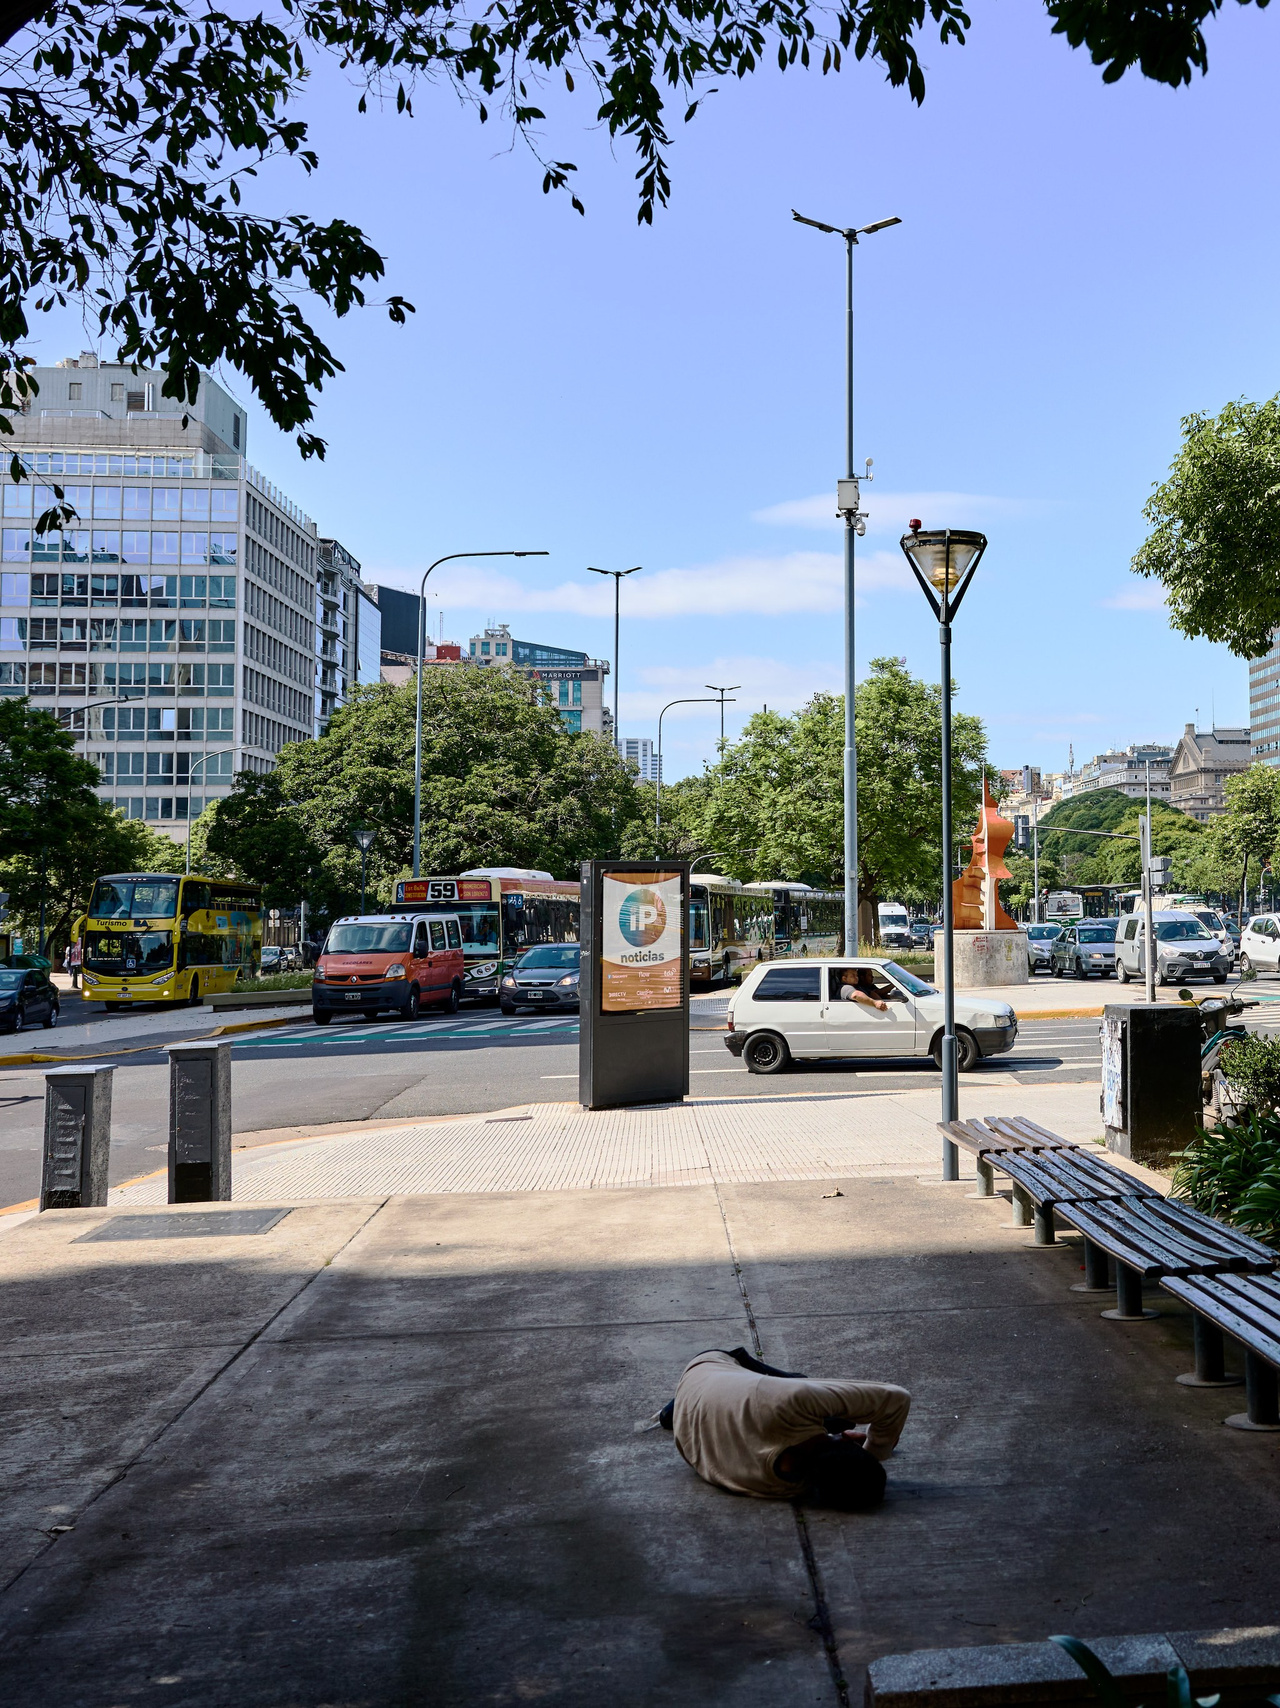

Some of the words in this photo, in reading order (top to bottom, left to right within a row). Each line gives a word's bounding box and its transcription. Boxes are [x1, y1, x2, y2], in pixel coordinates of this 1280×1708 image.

[430, 882, 455, 899] 59
[96, 919, 128, 927] Turismo
[620, 950, 665, 963] noticias
